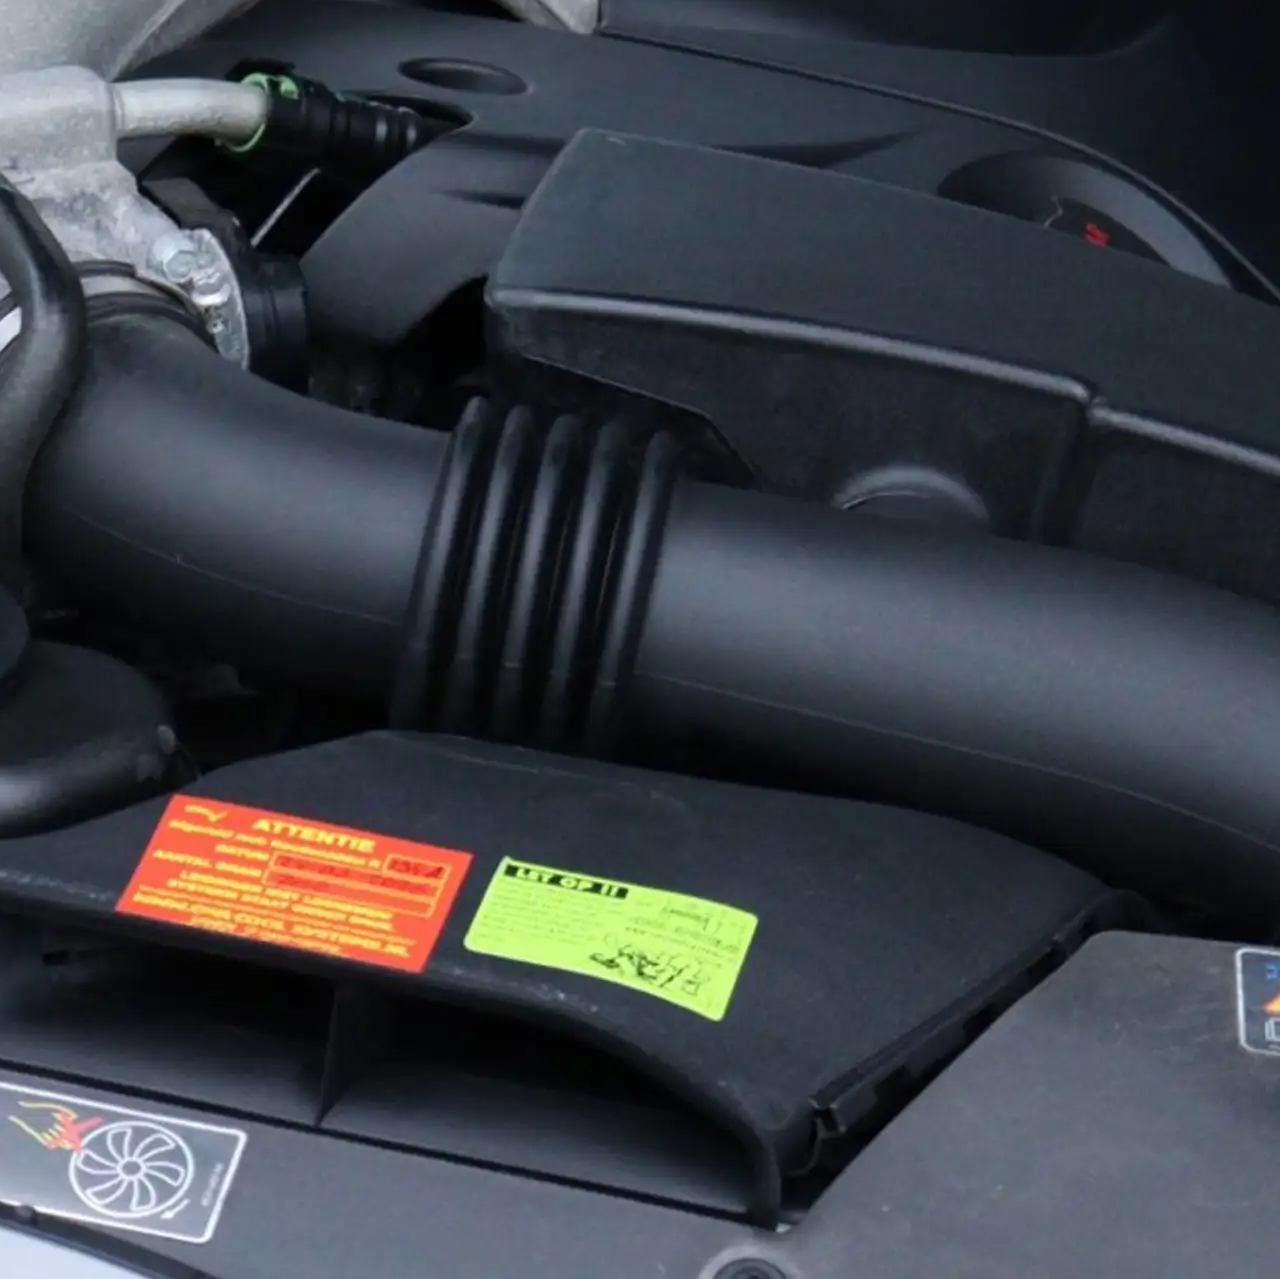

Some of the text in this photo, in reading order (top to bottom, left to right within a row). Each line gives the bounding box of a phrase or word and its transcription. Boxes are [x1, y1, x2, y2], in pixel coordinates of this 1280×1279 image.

[251, 818, 376, 854] ATTENTIE
[516, 867, 552, 886] LET
[560, 877, 595, 892] OP
